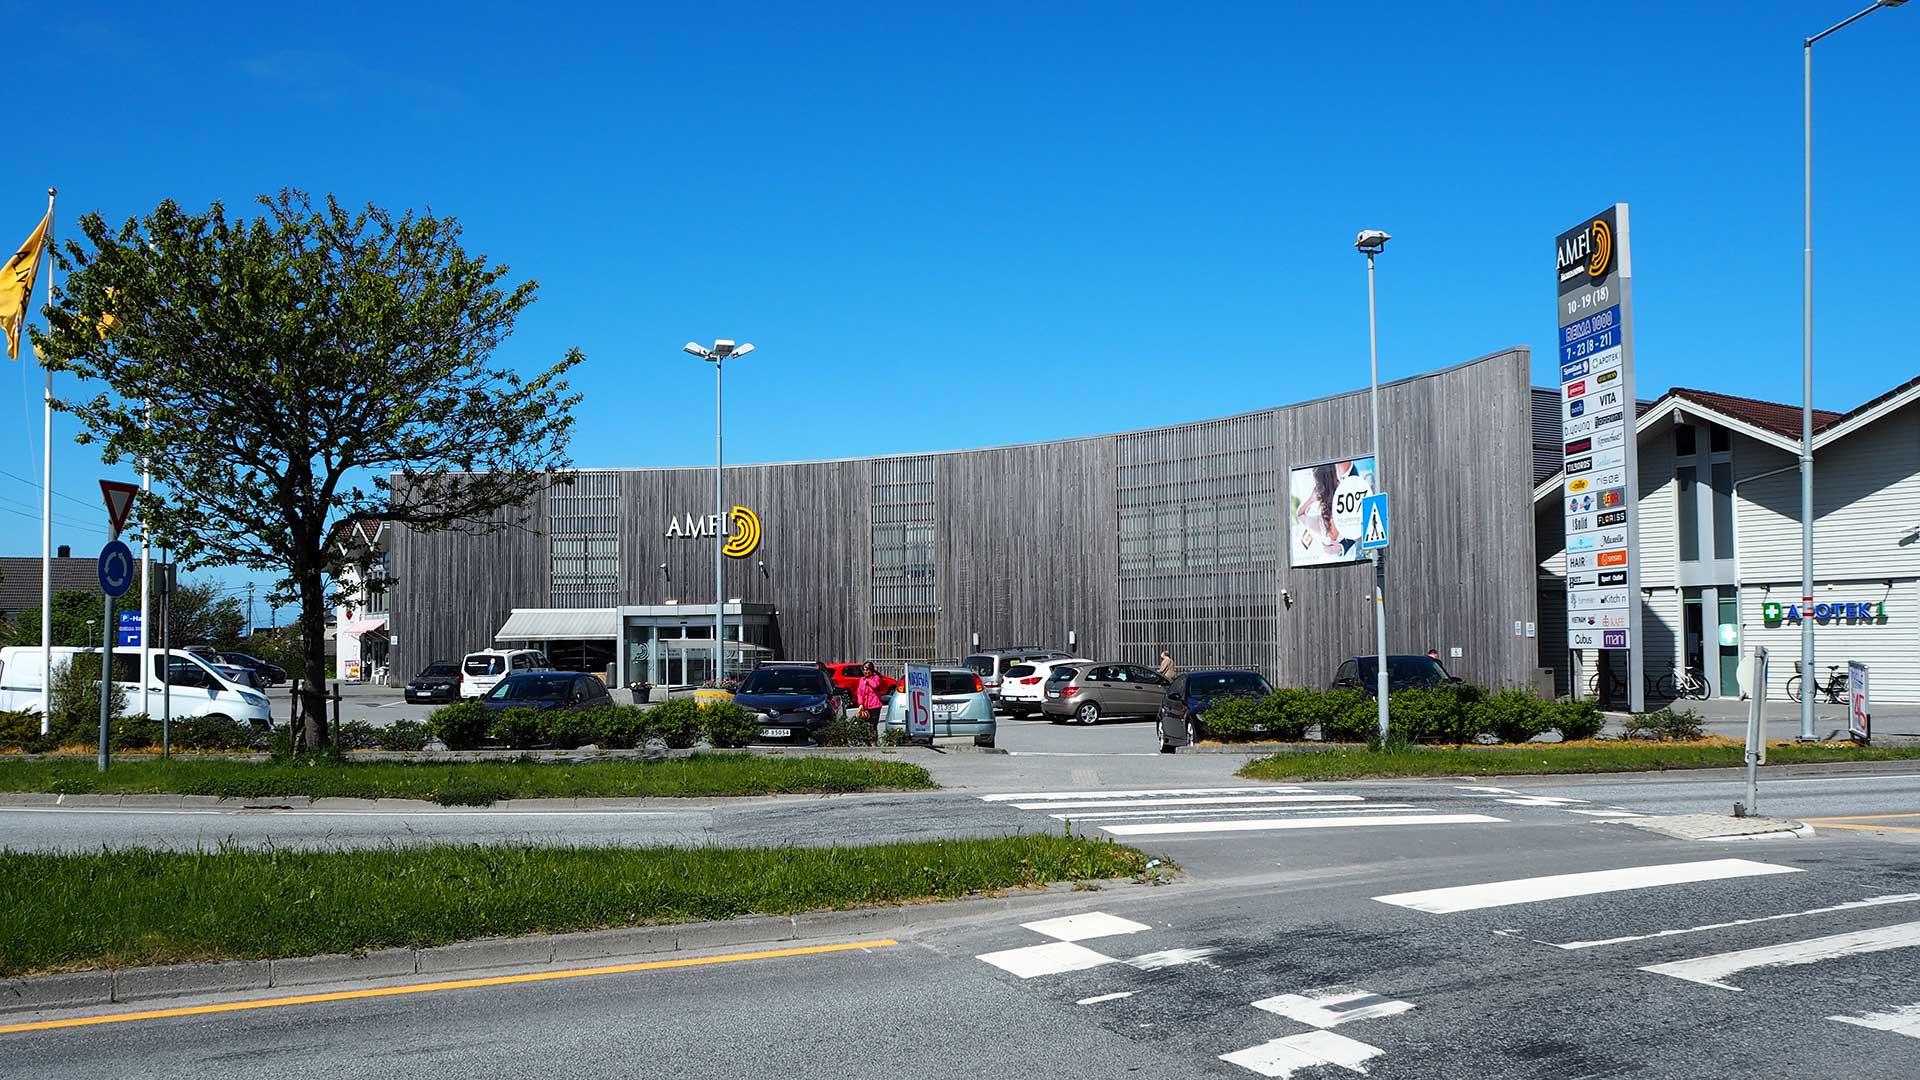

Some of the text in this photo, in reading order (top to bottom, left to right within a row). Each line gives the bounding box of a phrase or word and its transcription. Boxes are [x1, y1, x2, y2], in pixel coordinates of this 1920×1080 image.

[1556, 227, 1591, 270] AMFI
[1592, 286, 1609, 307] (18)
[1565, 311, 1612, 342] REMA 1000
[1600, 392, 1616, 406] VITA
[665, 511, 728, 538] AMFI
[1570, 557, 1585, 568] HAIR
[1787, 603, 1872, 619] AOTEK
[1575, 634, 1592, 645] Cubus
[1605, 631, 1624, 645] mani
[912, 691, 929, 726] 15
